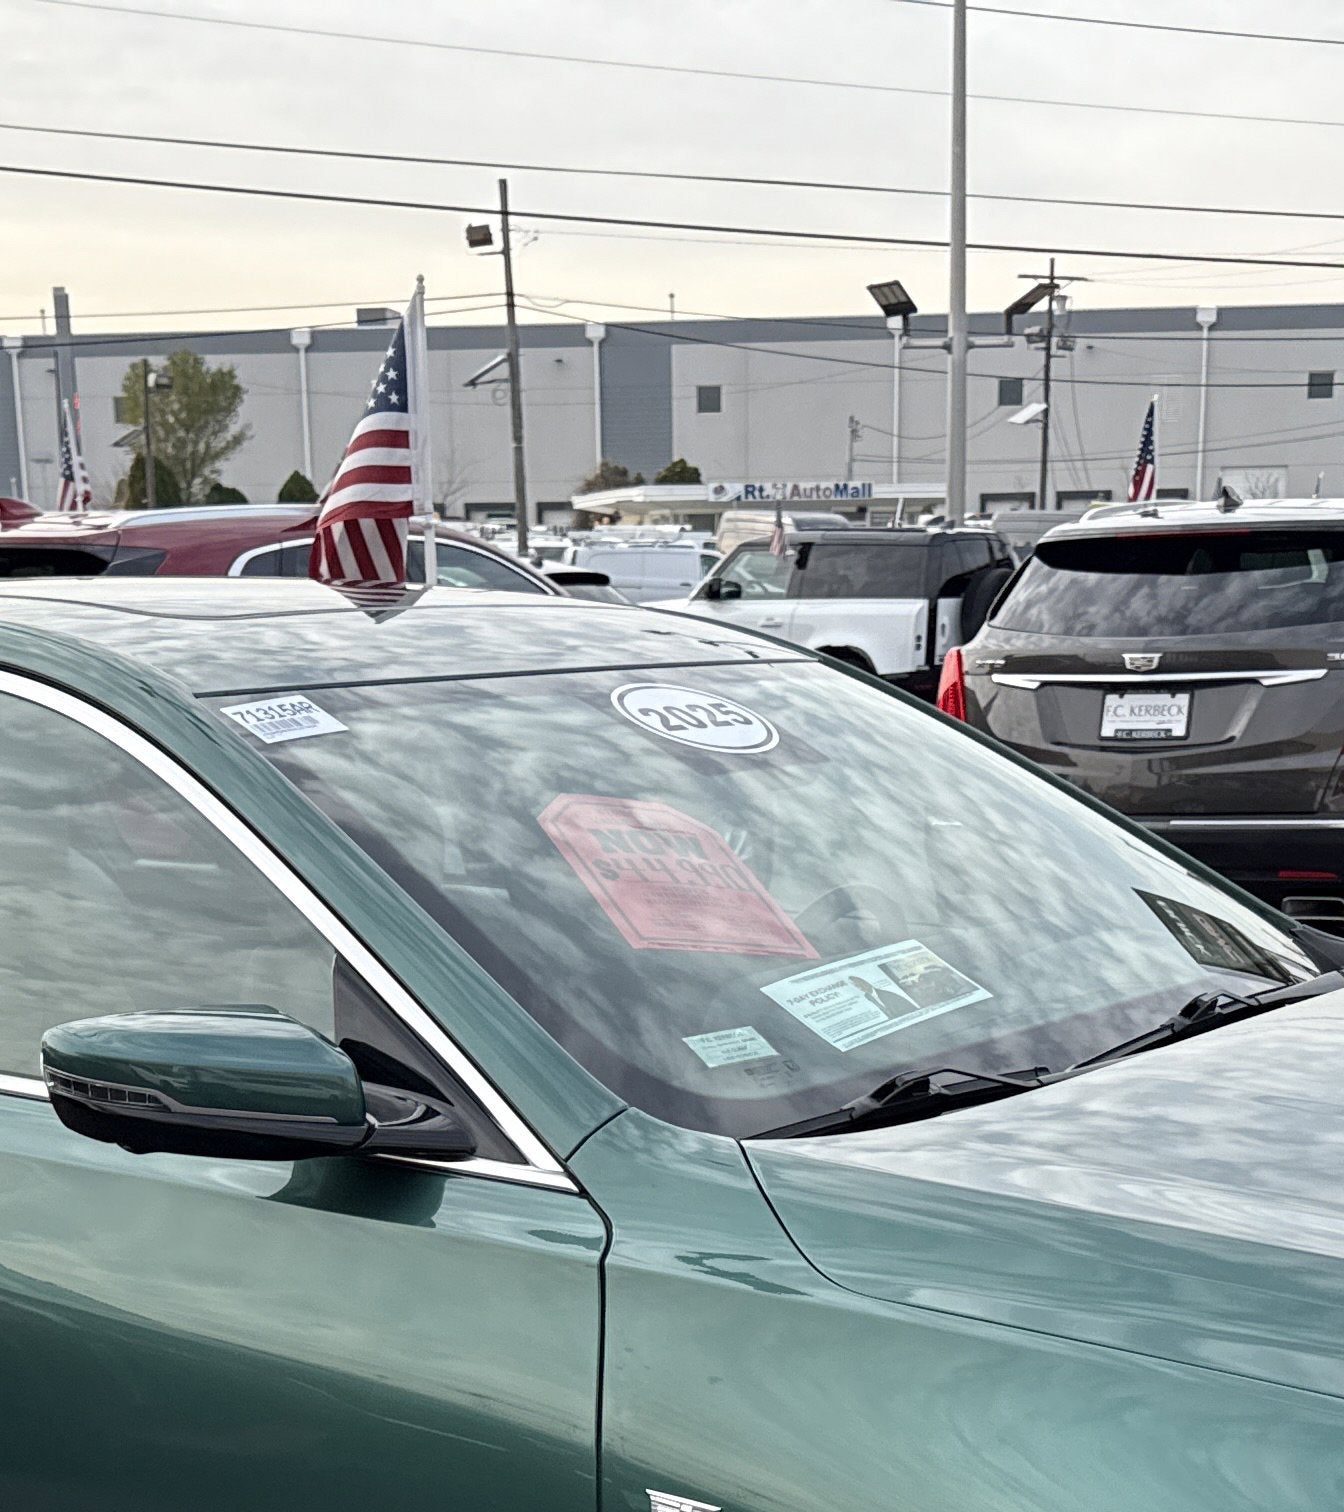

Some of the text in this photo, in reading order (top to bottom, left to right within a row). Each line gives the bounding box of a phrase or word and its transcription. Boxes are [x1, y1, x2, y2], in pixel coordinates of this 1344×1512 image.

[743, 484, 770, 500] Rt.
[789, 482, 873, 500] AutoMall
[231, 701, 321, 725] 71315AR
[637, 702, 754, 732] 2025
[1128, 704, 1185, 718] KERBECK
[588, 828, 707, 861] NOW
